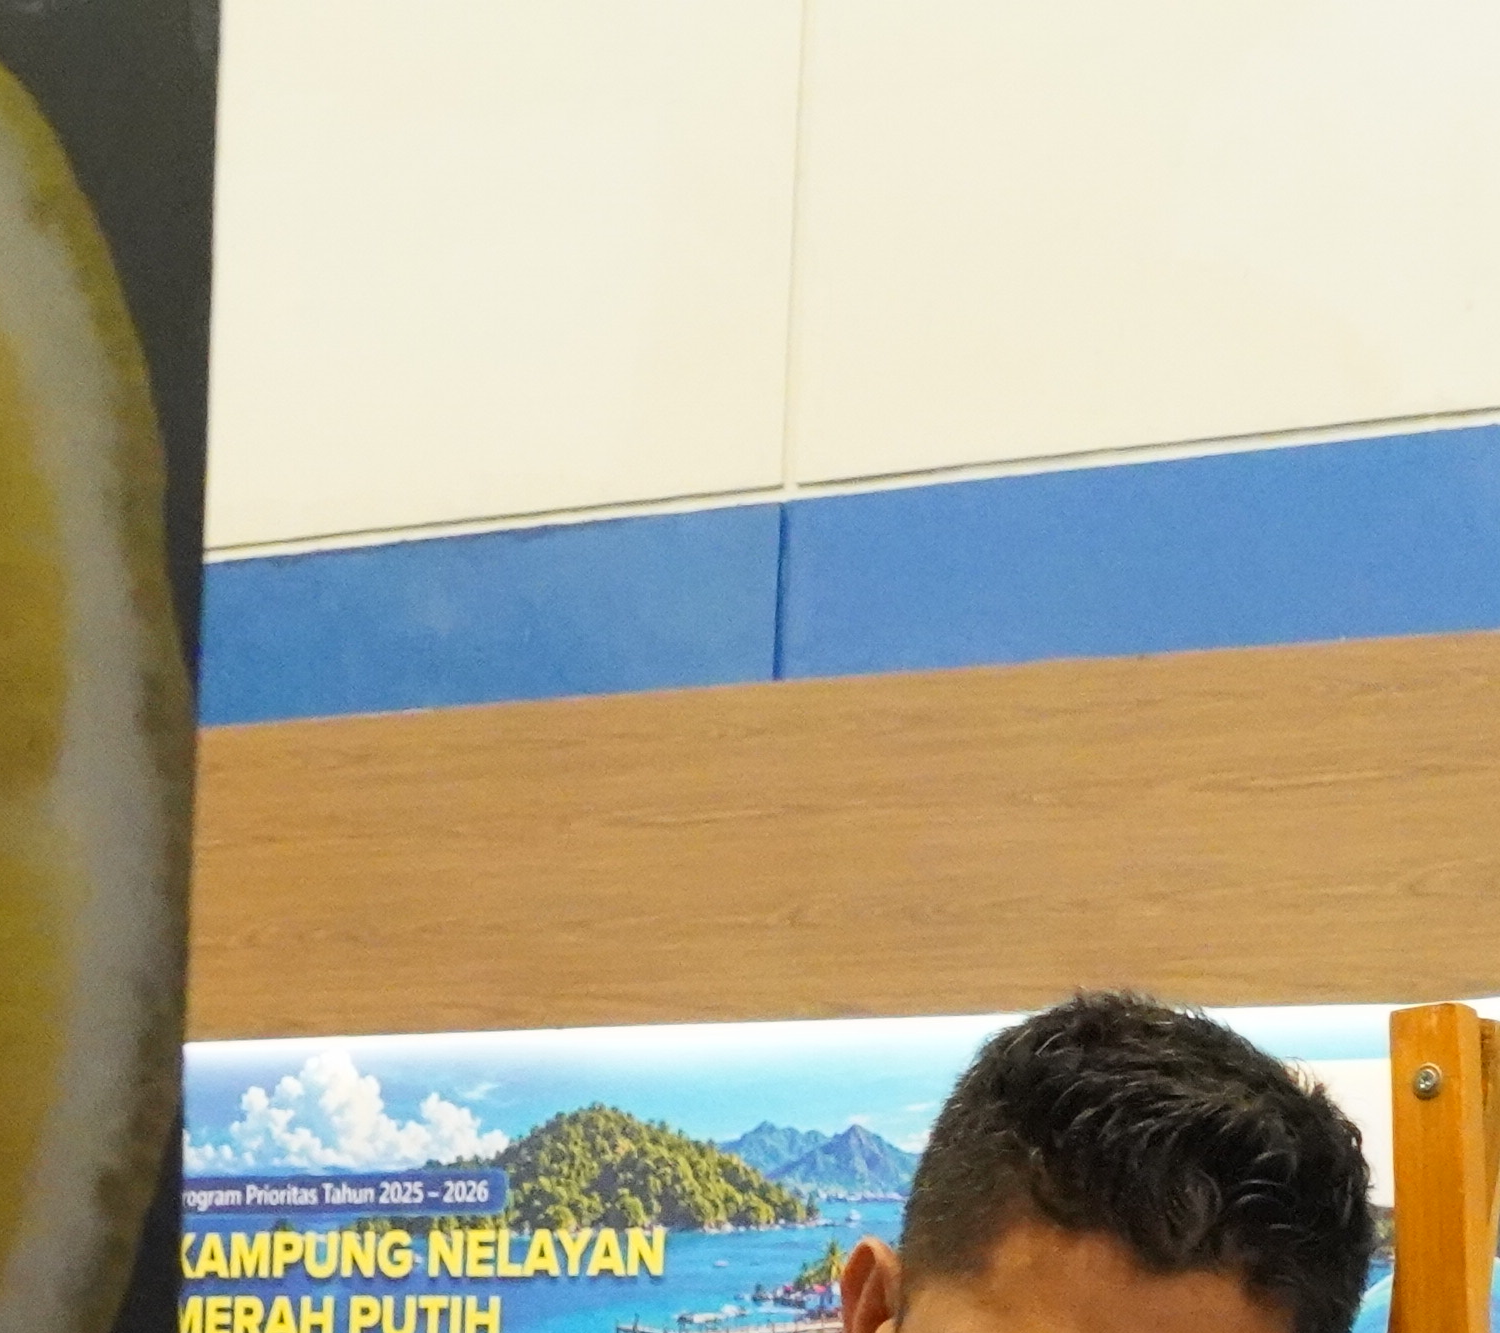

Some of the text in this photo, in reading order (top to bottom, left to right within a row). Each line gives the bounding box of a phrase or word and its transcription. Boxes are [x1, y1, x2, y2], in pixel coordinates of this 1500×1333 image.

[181, 1186, 242, 1212] rogram
[246, 1183, 318, 1207] Prioritas
[321, 1182, 376, 1204] Tahun
[378, 1180, 425, 1204] 2025
[442, 1179, 490, 1204] 2026
[427, 1227, 667, 1279] NELAYAN
